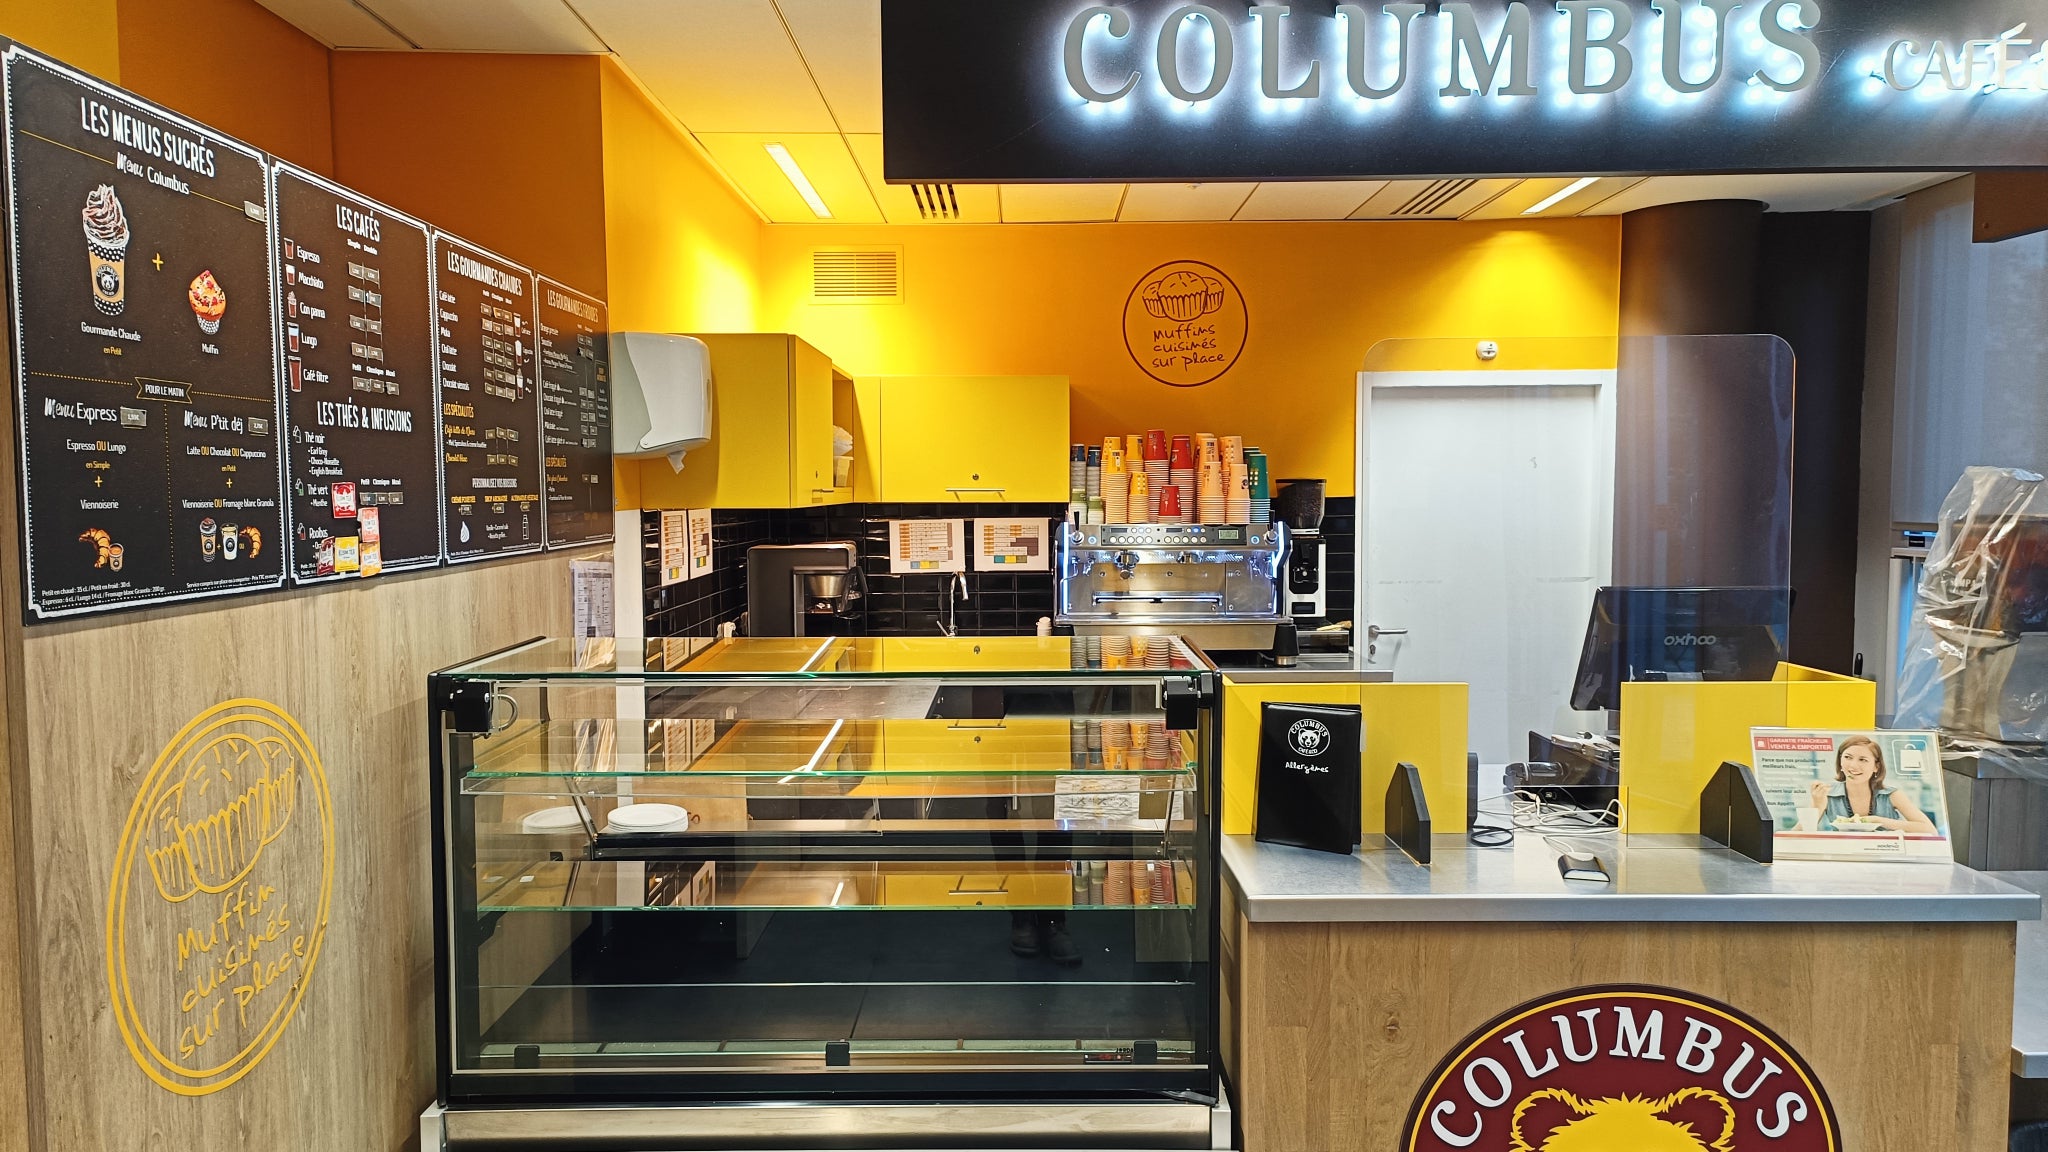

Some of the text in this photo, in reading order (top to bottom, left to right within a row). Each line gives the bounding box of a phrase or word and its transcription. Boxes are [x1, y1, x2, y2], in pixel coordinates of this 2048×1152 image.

[1064, 0, 1821, 102] COLUMBUS
[1885, 22, 2032, 91] CAFÉ
[80, 96, 215, 178] LES MENUS SUCRÉS
[116, 152, 190, 195] Menu Columbus
[336, 204, 380, 243] LES CAFÉS
[297, 246, 321, 264] Espresso
[447, 251, 460, 273] LES
[460, 255, 498, 288] GOURMANDES
[300, 302, 310, 316] Con
[81, 322, 142, 342] Gourmande Chaude
[301, 332, 318, 349] Lungo
[1153, 322, 1215, 342] Muffins
[202, 343, 220, 356] Muffin
[1153, 338, 1217, 353] cuisinés
[1152, 352, 1225, 372] sur place
[303, 368, 316, 382] Café
[145, 384, 185, 398] POUR LE MATIN
[44, 397, 117, 426] Menu Express
[317, 400, 412, 433] LES THÉS & INFUSIONS
[184, 410, 208, 429] Menu
[231, 416, 243, 435] déj
[66, 439, 127, 455] Espresso OU Lungo
[305, 431, 314, 444] Thé
[187, 445, 201, 455] Latte
[201, 446, 210, 456] OU
[210, 446, 232, 457] Chocolat
[232, 448, 240, 457] OU
[307, 484, 318, 495] Thé
[80, 499, 119, 510] Viennoiserie
[182, 499, 275, 510] Viennoiserie OU Fromage blanc Granola
[1664, 632, 1717, 646] oxhoo
[1290, 720, 1328, 737] COLUMBUS
[178, 882, 276, 971] Muffin
[182, 904, 291, 1013] cuisinés
[179, 935, 306, 1060] sur place
[1430, 1006, 1808, 1148] COLUMBUS
